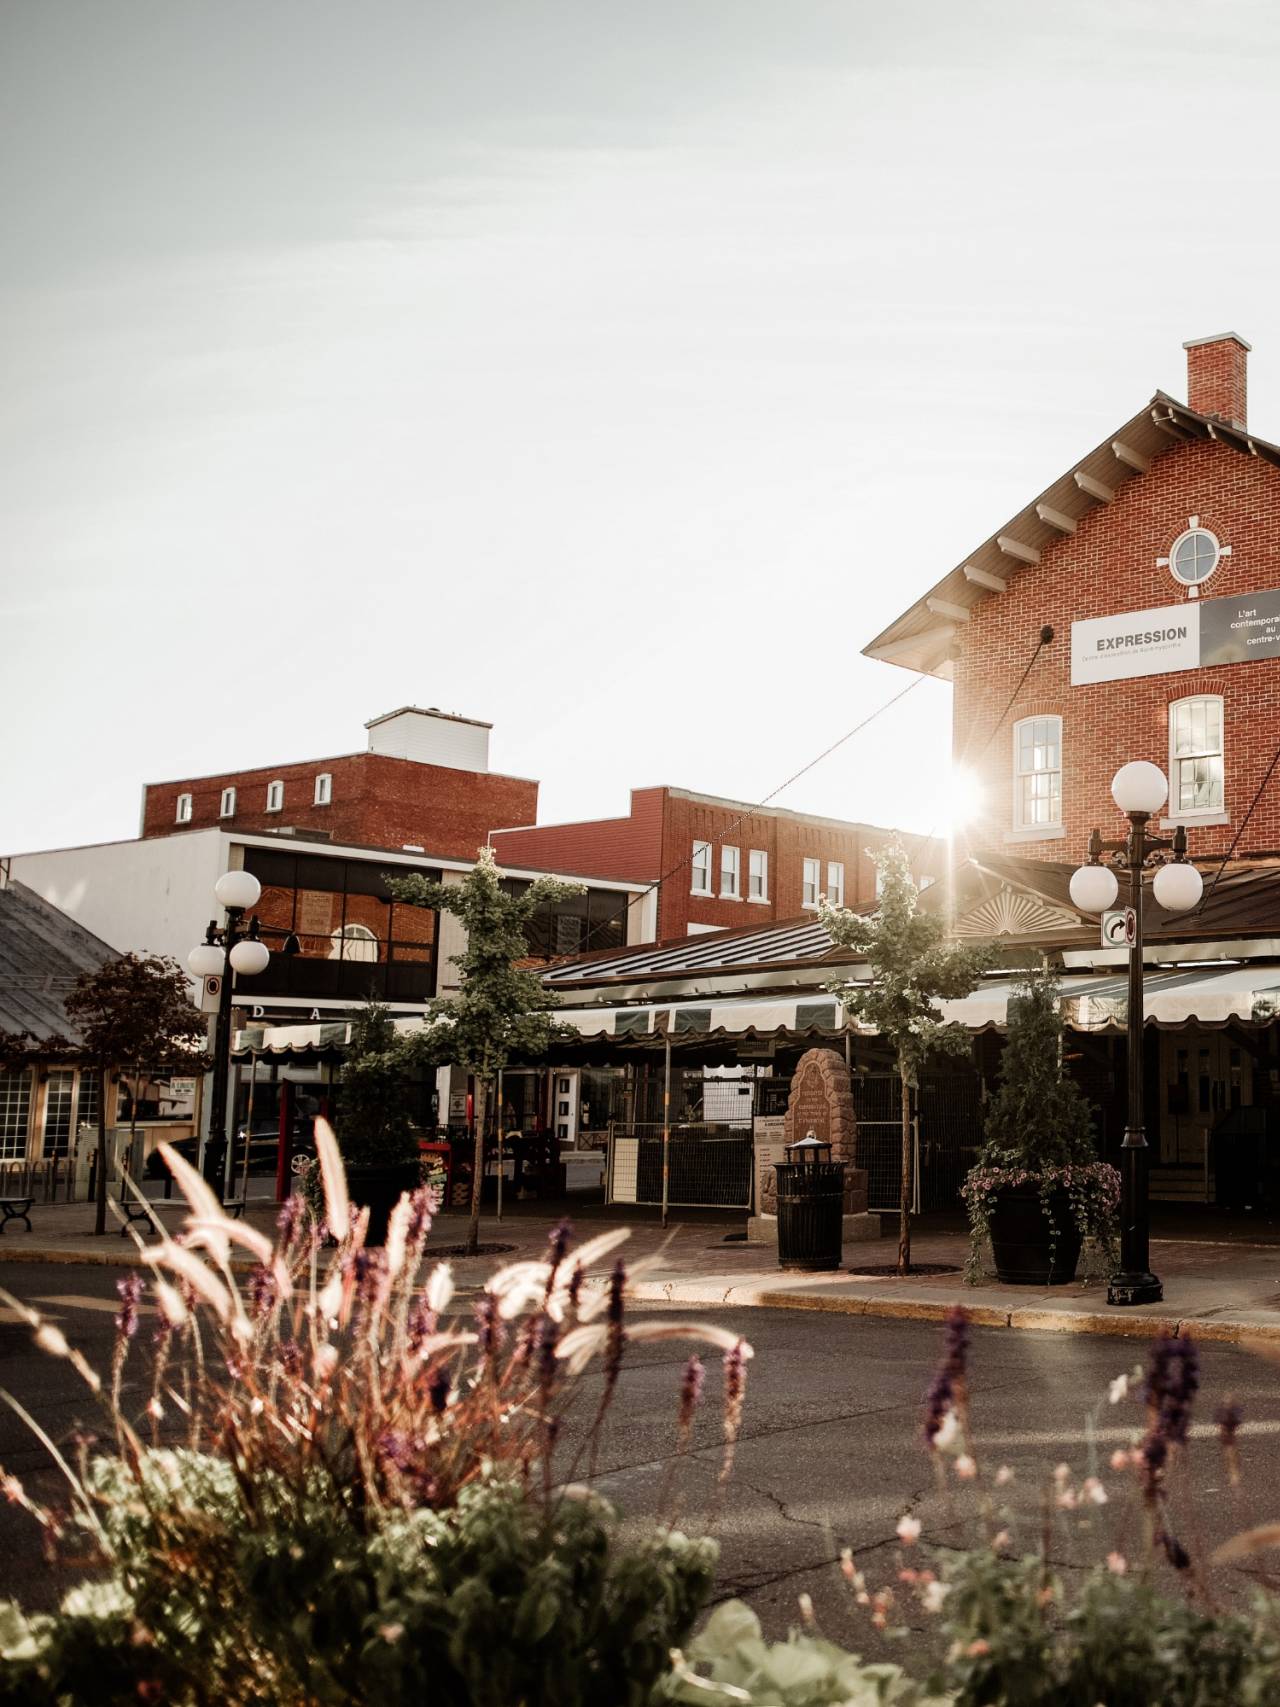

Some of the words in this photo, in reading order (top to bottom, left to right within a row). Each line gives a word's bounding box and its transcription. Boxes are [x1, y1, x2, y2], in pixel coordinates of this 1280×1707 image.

[1238, 609, 1257, 618] L'art
[1265, 626, 1276, 634] au
[1096, 626, 1188, 652] EXPRESSION
